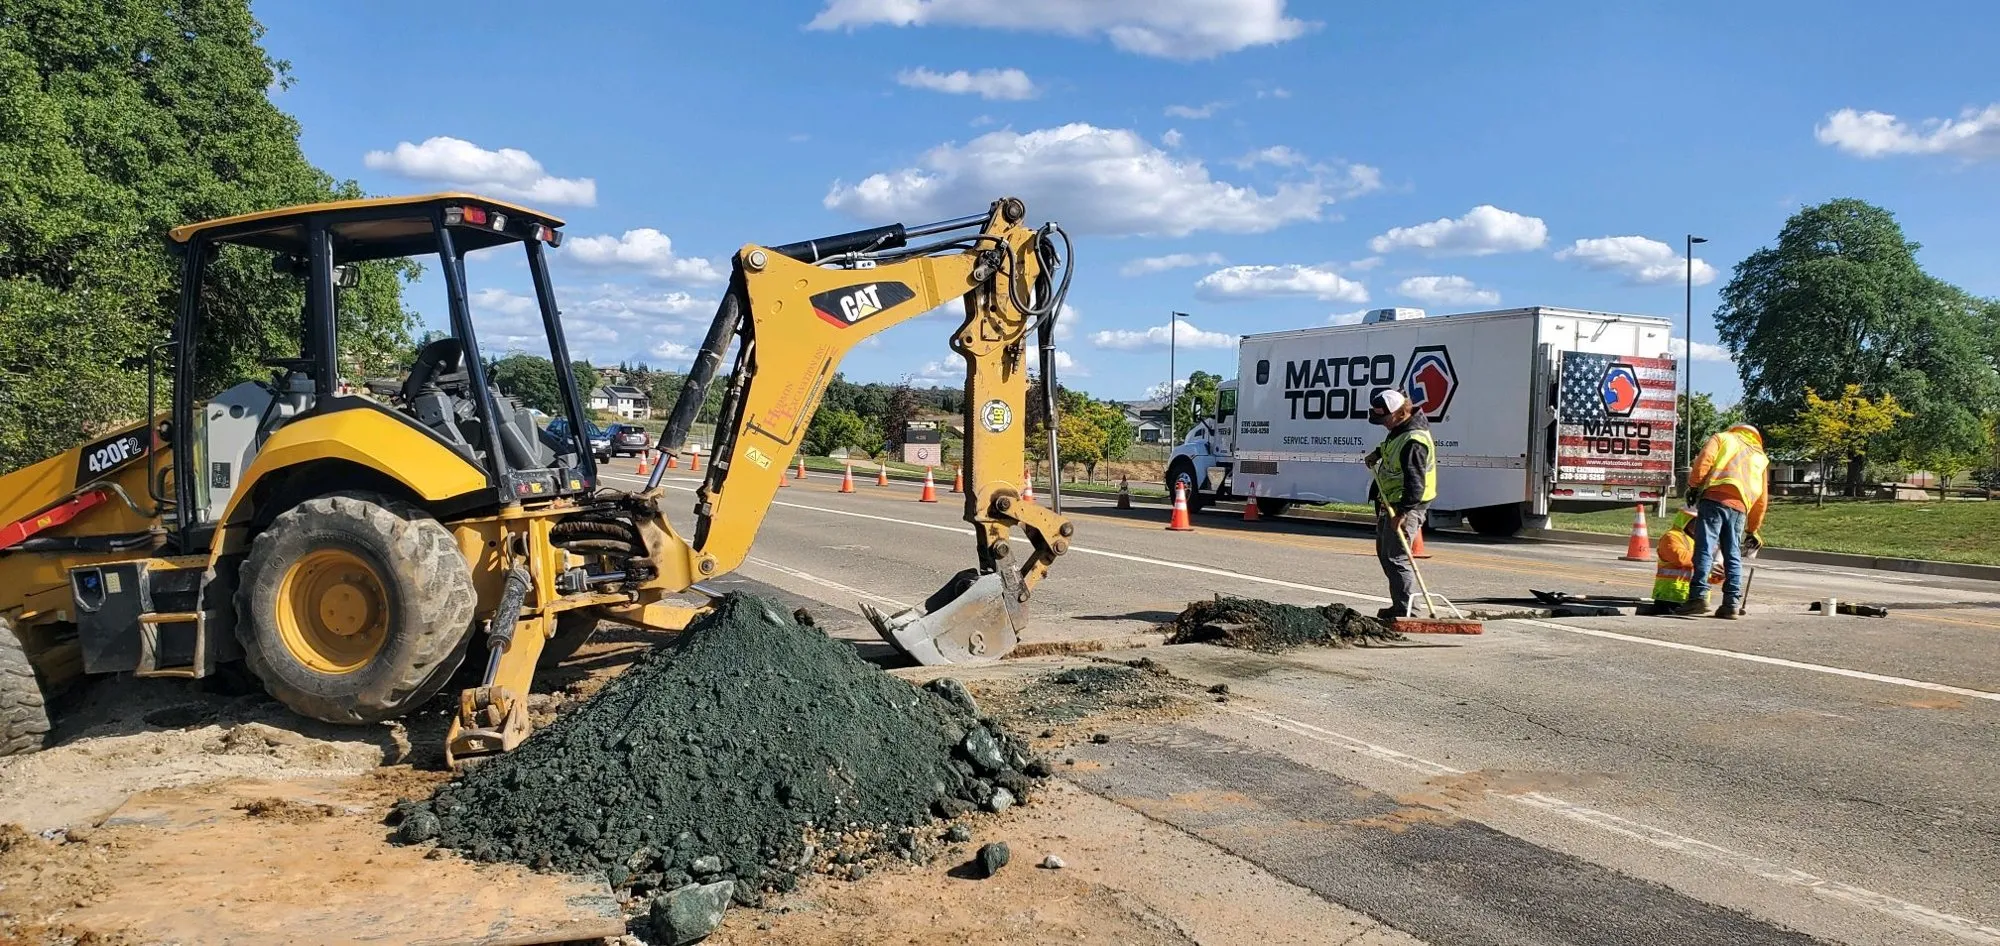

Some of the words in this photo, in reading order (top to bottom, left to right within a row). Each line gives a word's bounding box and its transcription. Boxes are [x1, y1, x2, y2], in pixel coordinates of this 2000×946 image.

[840, 284, 882, 322] CAT
[1286, 354, 1395, 389] MATCO
[993, 407, 1004, 424] 811
[1583, 420, 1651, 438] MATCO
[1333, 437, 1364, 446] RESULTS.
[1583, 437, 1651, 455] TOOLS
[89, 437, 141, 472] 420F2
